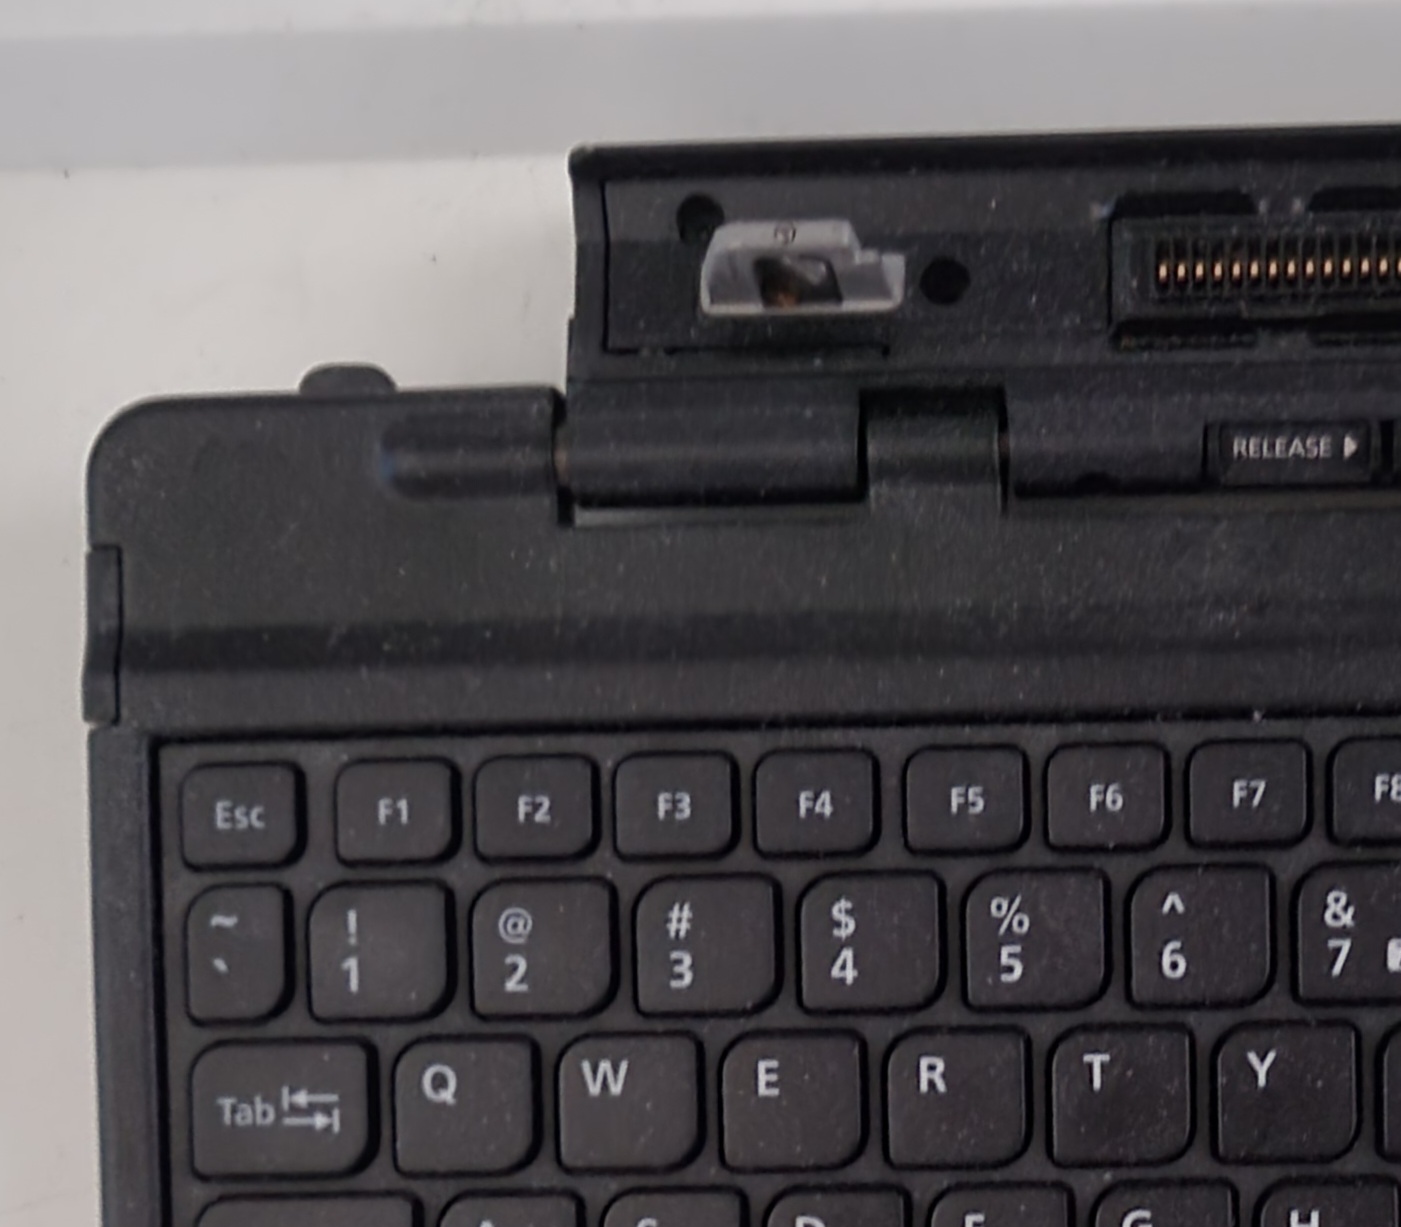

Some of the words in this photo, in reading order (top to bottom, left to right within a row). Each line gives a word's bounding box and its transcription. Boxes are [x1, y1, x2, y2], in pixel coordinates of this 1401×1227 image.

[1233, 436, 1330, 458] RELEASE
[379, 798, 407, 824] F1
[518, 795, 550, 822] F2
[658, 793, 690, 819] F3
[799, 791, 832, 817] F4
[951, 787, 984, 813] F5
[1090, 784, 1123, 811] F6
[1233, 780, 1265, 807] F7
[216, 801, 264, 829] Esc
[667, 903, 692, 938] #
[832, 899, 855, 939] $
[991, 896, 1029, 935] %
[1163, 893, 1184, 913] ^
[1325, 891, 1354, 927] &
[211, 915, 237, 927] ~
[348, 910, 357, 945] !
[498, 908, 532, 944] @
[342, 957, 358, 992] 1
[505, 955, 528, 991] 2
[670, 951, 692, 987] 3
[831, 948, 857, 984] 4
[1001, 946, 1022, 982] 5
[1162, 941, 1186, 978] 6
[1328, 939, 1351, 975] 7
[423, 1065, 456, 1104] Q
[582, 1060, 628, 1096] W
[758, 1060, 779, 1096] E
[920, 1057, 945, 1092] R
[1083, 1054, 1110, 1090] T
[1248, 1051, 1276, 1087] Y
[218, 1096, 275, 1125] Tab
